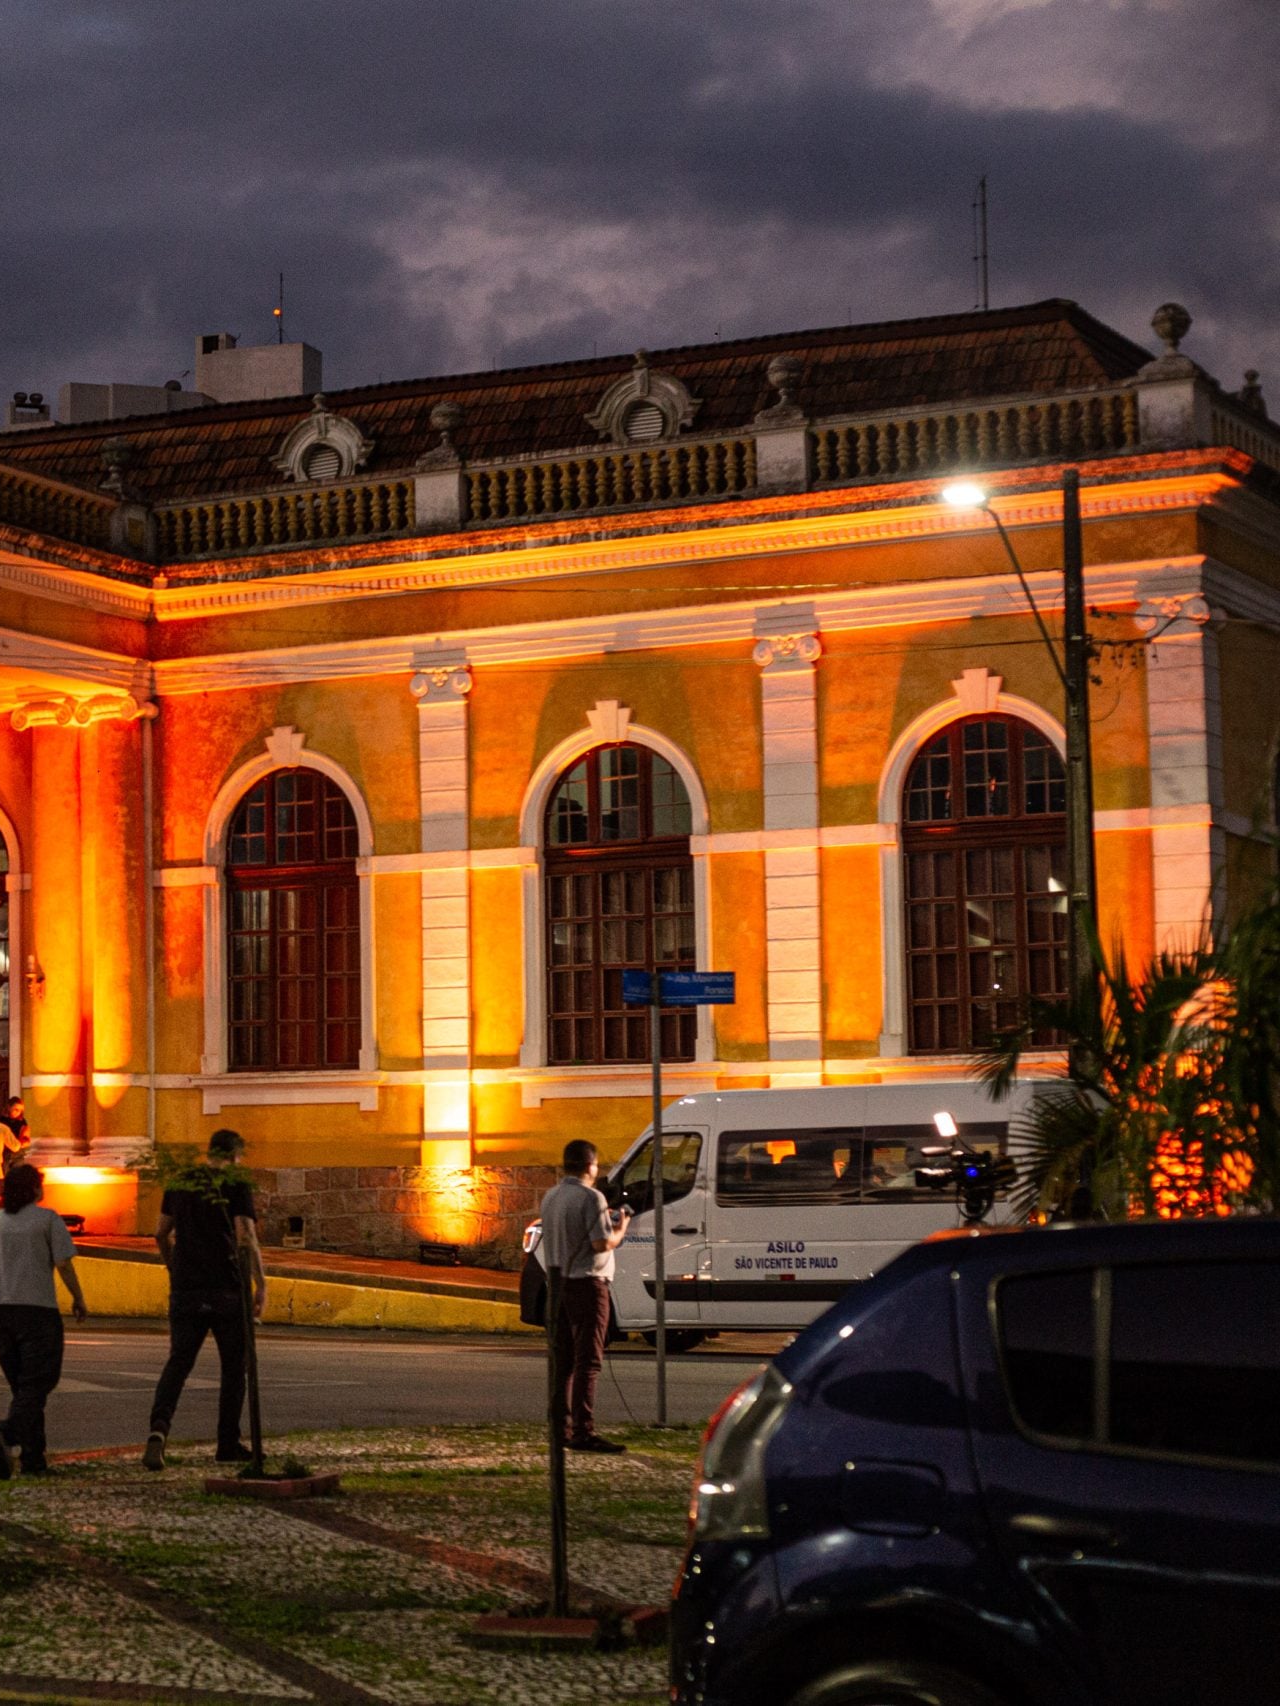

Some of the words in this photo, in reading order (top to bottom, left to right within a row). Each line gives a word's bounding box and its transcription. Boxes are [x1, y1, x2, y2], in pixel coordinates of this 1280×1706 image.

[767, 1241, 805, 1253] ASILO
[735, 1256, 753, 1269] SÃO
[755, 1258, 793, 1269] VICENTE
[795, 1258, 807, 1269] DE
[809, 1257, 838, 1268] PAULO
